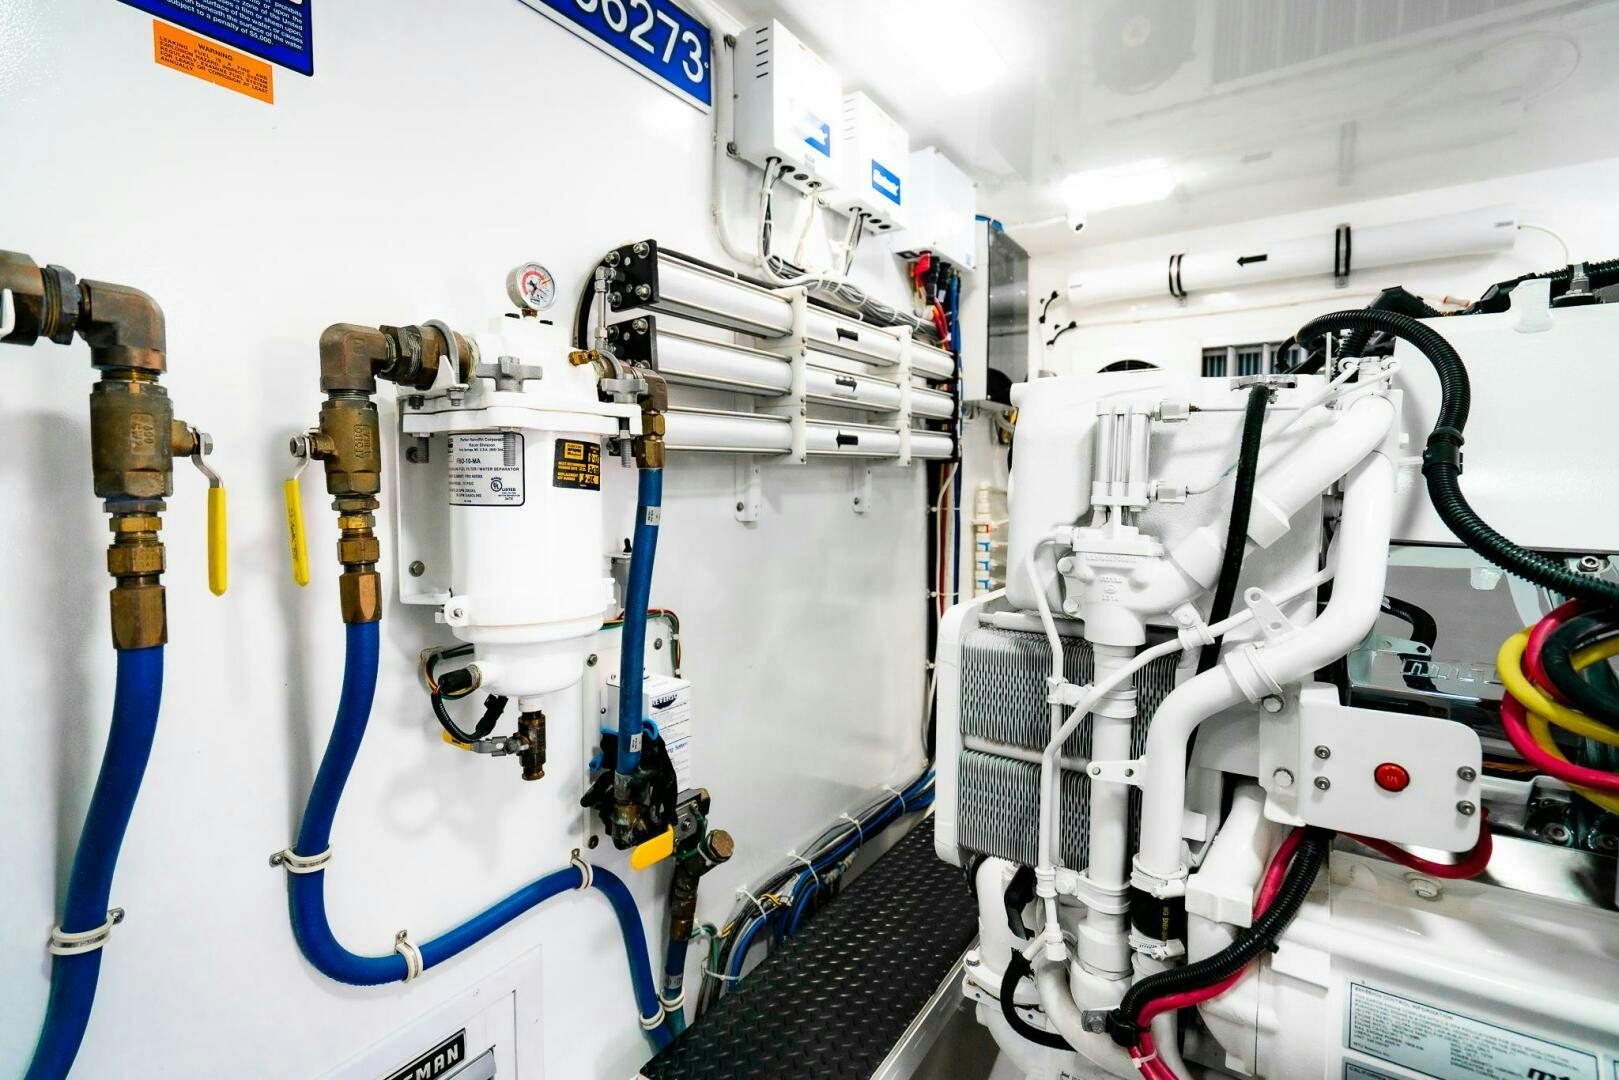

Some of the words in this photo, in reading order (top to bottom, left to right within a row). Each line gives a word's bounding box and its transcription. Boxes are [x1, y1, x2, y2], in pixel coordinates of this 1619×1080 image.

[195, 0, 224, 18] beneath
[226, 13, 237, 23] the
[239, 19, 263, 34] surface
[265, 29, 272, 38] of
[273, 33, 283, 42] the
[196, 8, 204, 16] to
[213, 16, 238, 31] penalty
[241, 26, 247, 34] of
[241, 6, 253, 16] film
[264, 16, 283, 29] sheen
[242, 0, 258, 11] zone
[261, 7, 267, 15] of
[270, 11, 279, 21] the
[282, 17, 302, 31] United
[263, 2, 269, 10] or
[273, 7, 289, 18] upon
[292, 15, 302, 24] the
[230, 8, 237, 16] of
[239, 12, 250, 21] the
[281, 30, 303, 44] causes
[159, 35, 187, 50] LEAKING
[194, 49, 209, 58] FUEL
[159, 40, 193, 56] EXPLOSION
[198, 43, 232, 61] WARNING
[175, 56, 194, 67] LEAKS
[200, 61, 226, 74] EXAMINE
[403, 1043, 459, 1080] MAN
